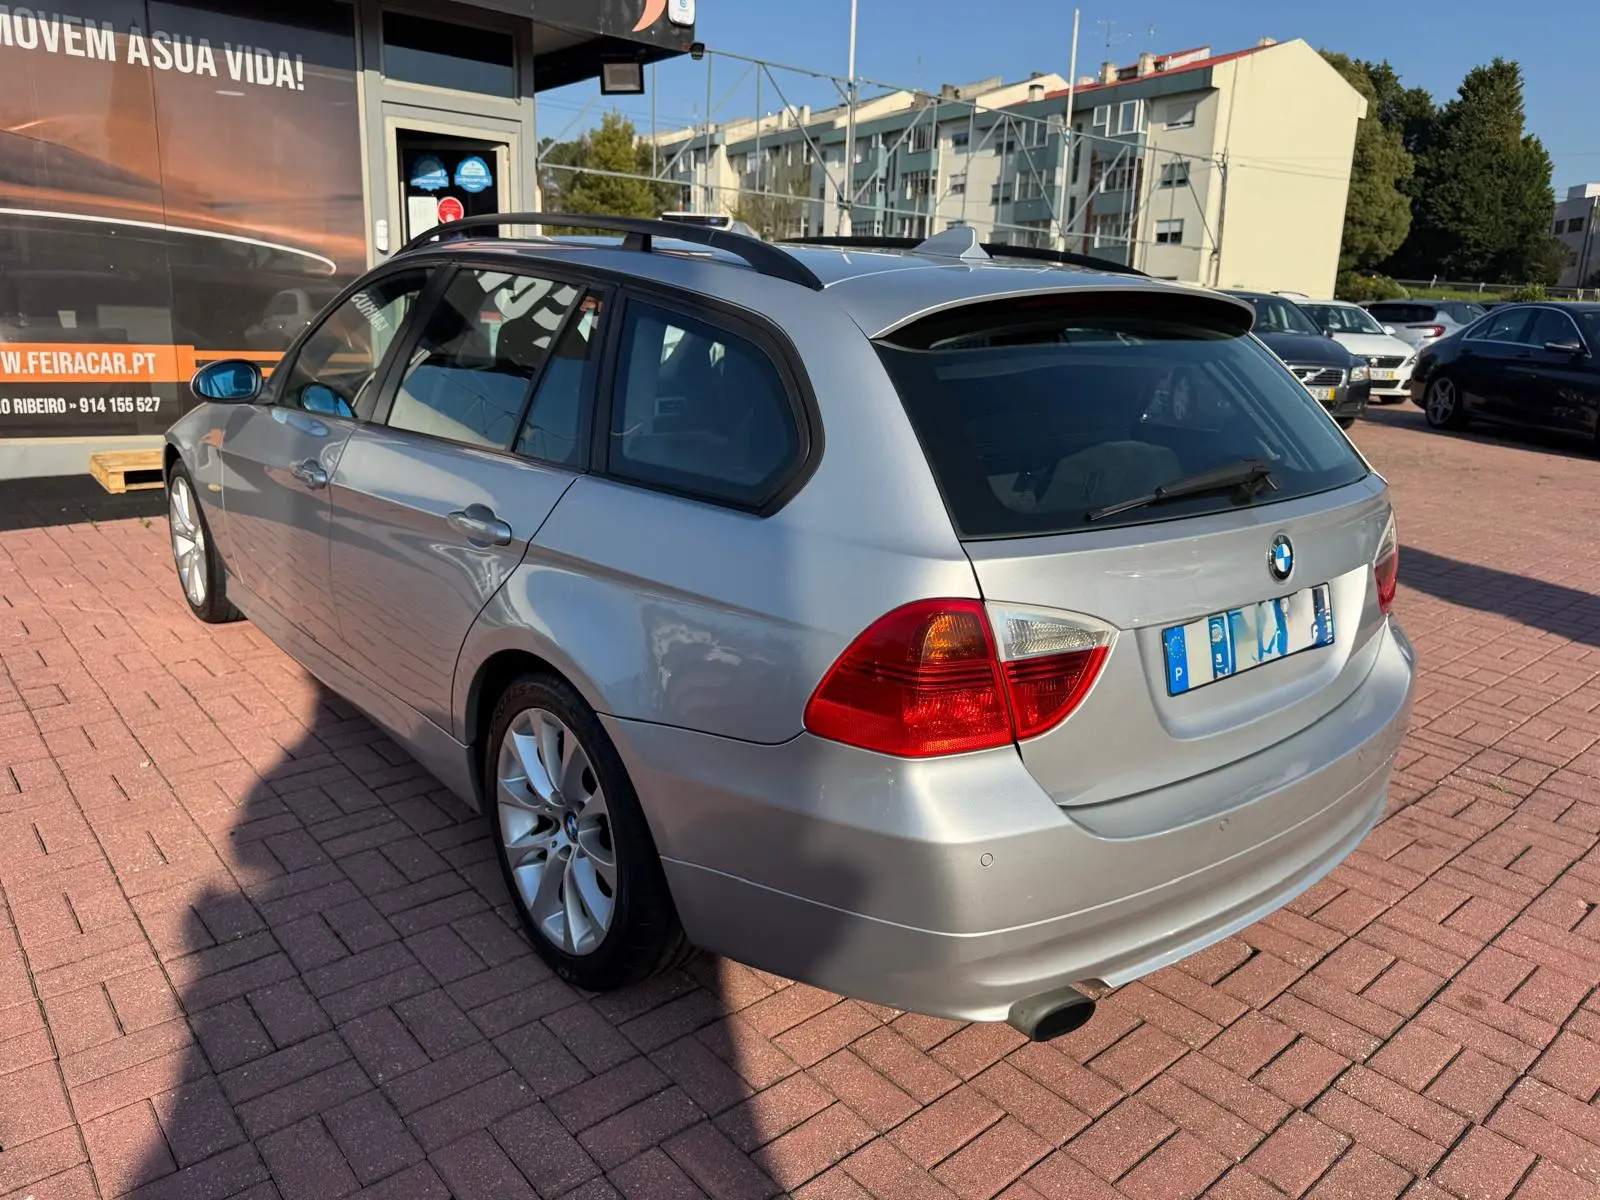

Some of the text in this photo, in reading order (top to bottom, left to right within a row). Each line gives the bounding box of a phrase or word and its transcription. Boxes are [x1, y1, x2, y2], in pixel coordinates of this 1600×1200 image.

[224, 41, 304, 91] VIDA!
[0, 398, 11, 414] O
[13, 397, 67, 414] RIBEIRO
[79, 397, 106, 413] 914
[109, 396, 134, 413] 155
[136, 396, 160, 412] 527
[1175, 667, 1183, 681] P
